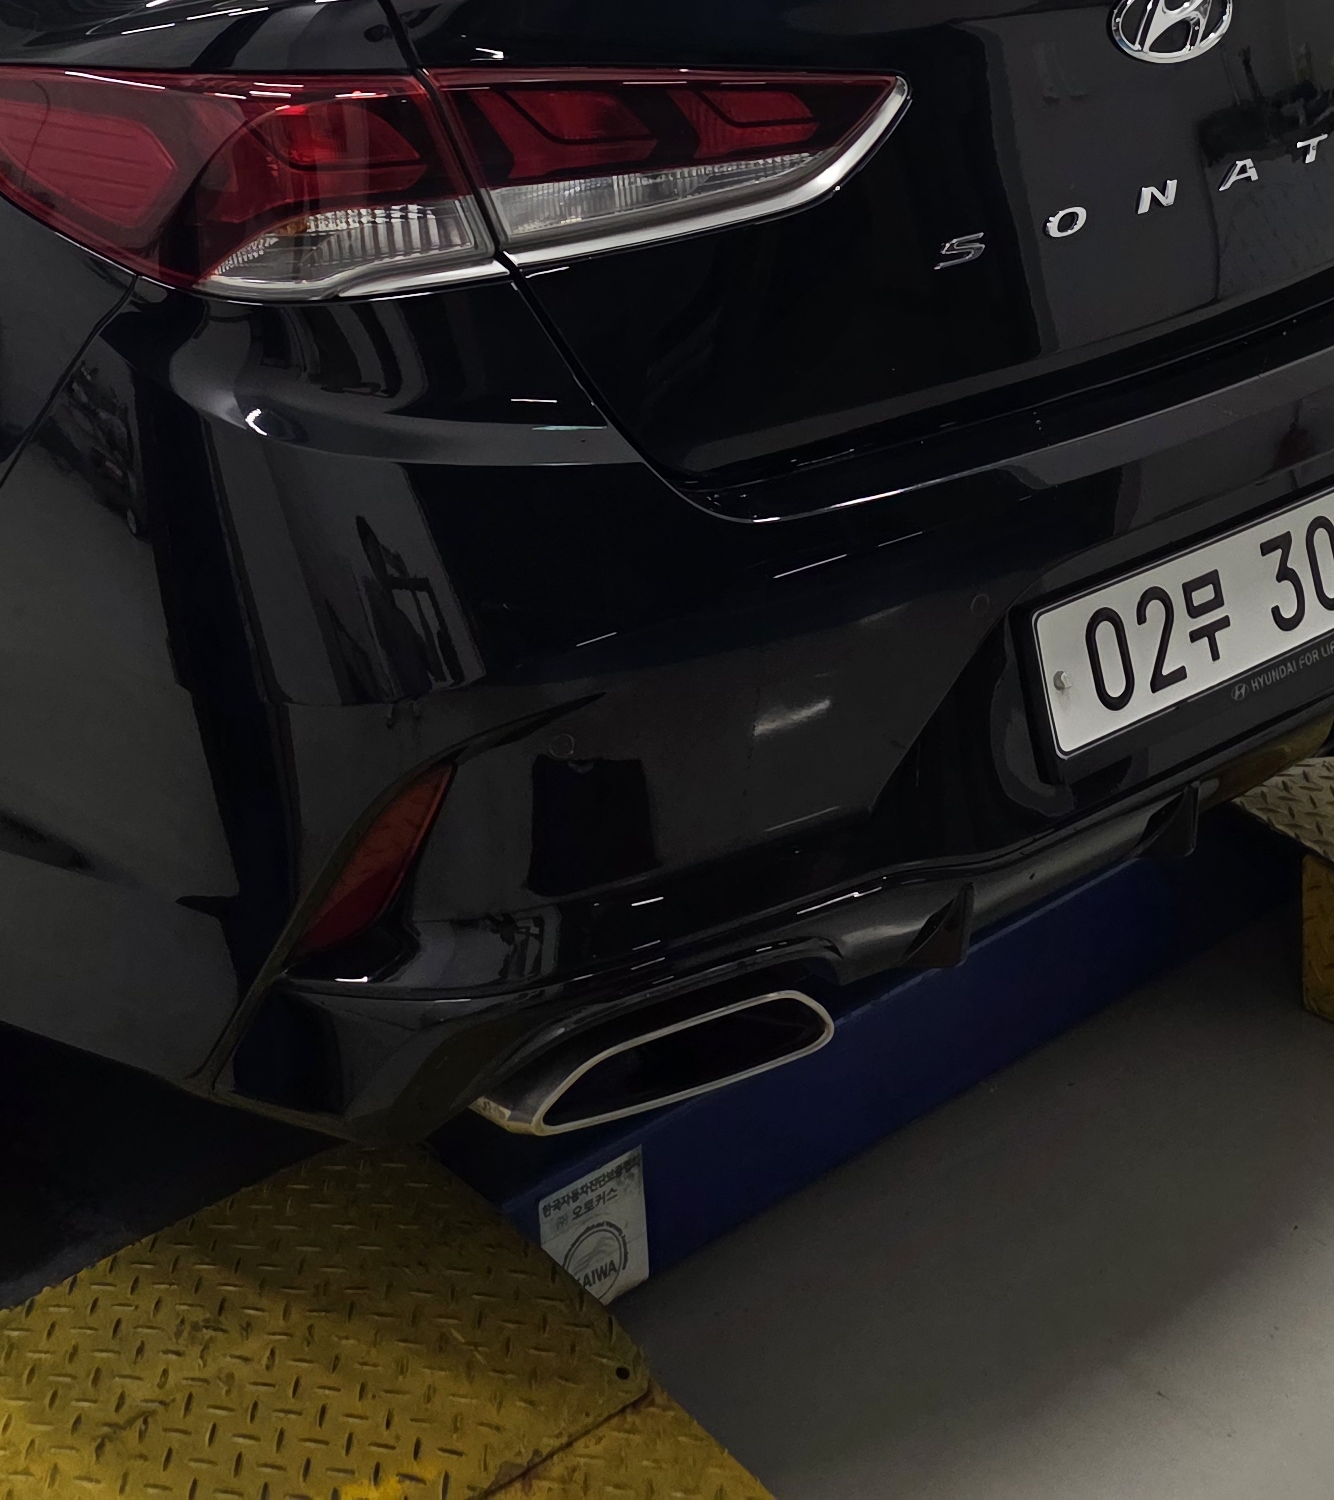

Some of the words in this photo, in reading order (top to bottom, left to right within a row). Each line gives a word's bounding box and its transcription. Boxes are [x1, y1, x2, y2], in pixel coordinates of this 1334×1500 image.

[1085, 568, 1231, 712] 02무
[1251, 661, 1297, 692] HYUNDAI
[1299, 650, 1321, 669] FOR
[572, 1187, 619, 1219] 오토커스
